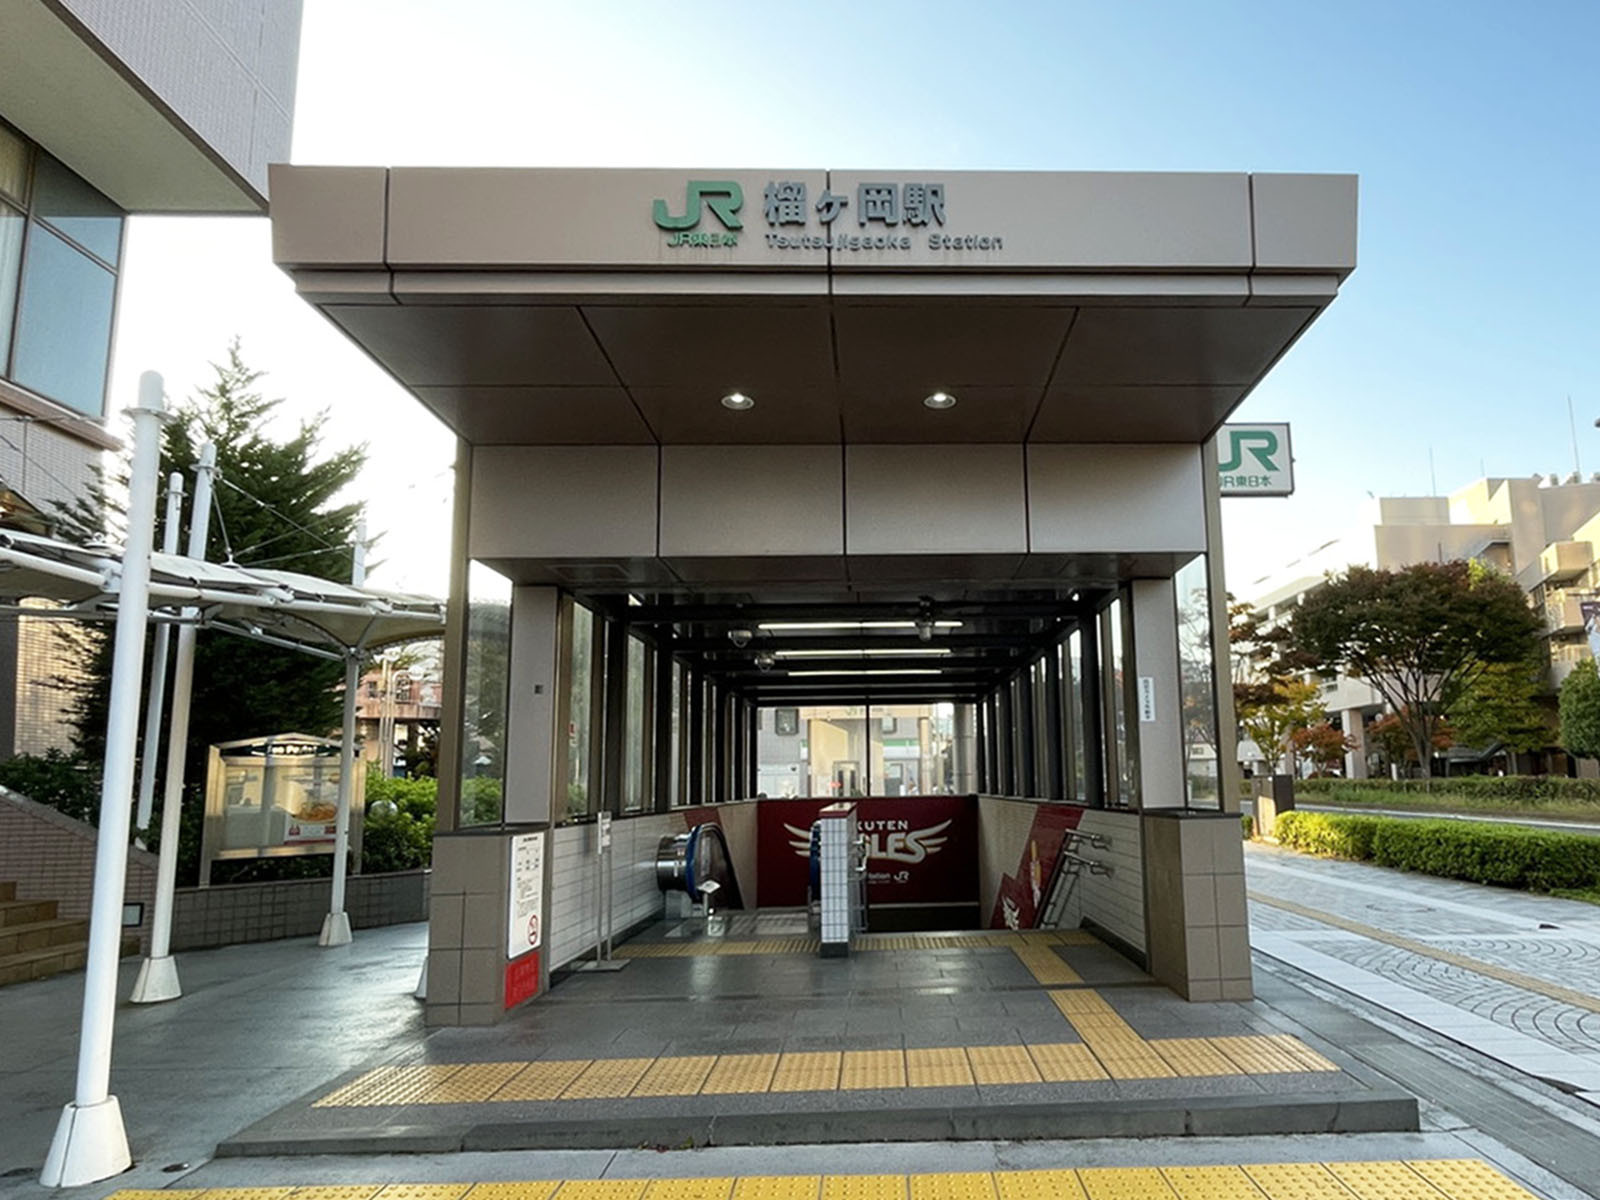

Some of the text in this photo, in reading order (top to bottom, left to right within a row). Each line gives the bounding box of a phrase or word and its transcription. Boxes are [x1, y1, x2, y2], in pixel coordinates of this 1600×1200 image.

[652, 180, 744, 231] JR
[765, 233, 1003, 251] Tsutsujigaoka Station
